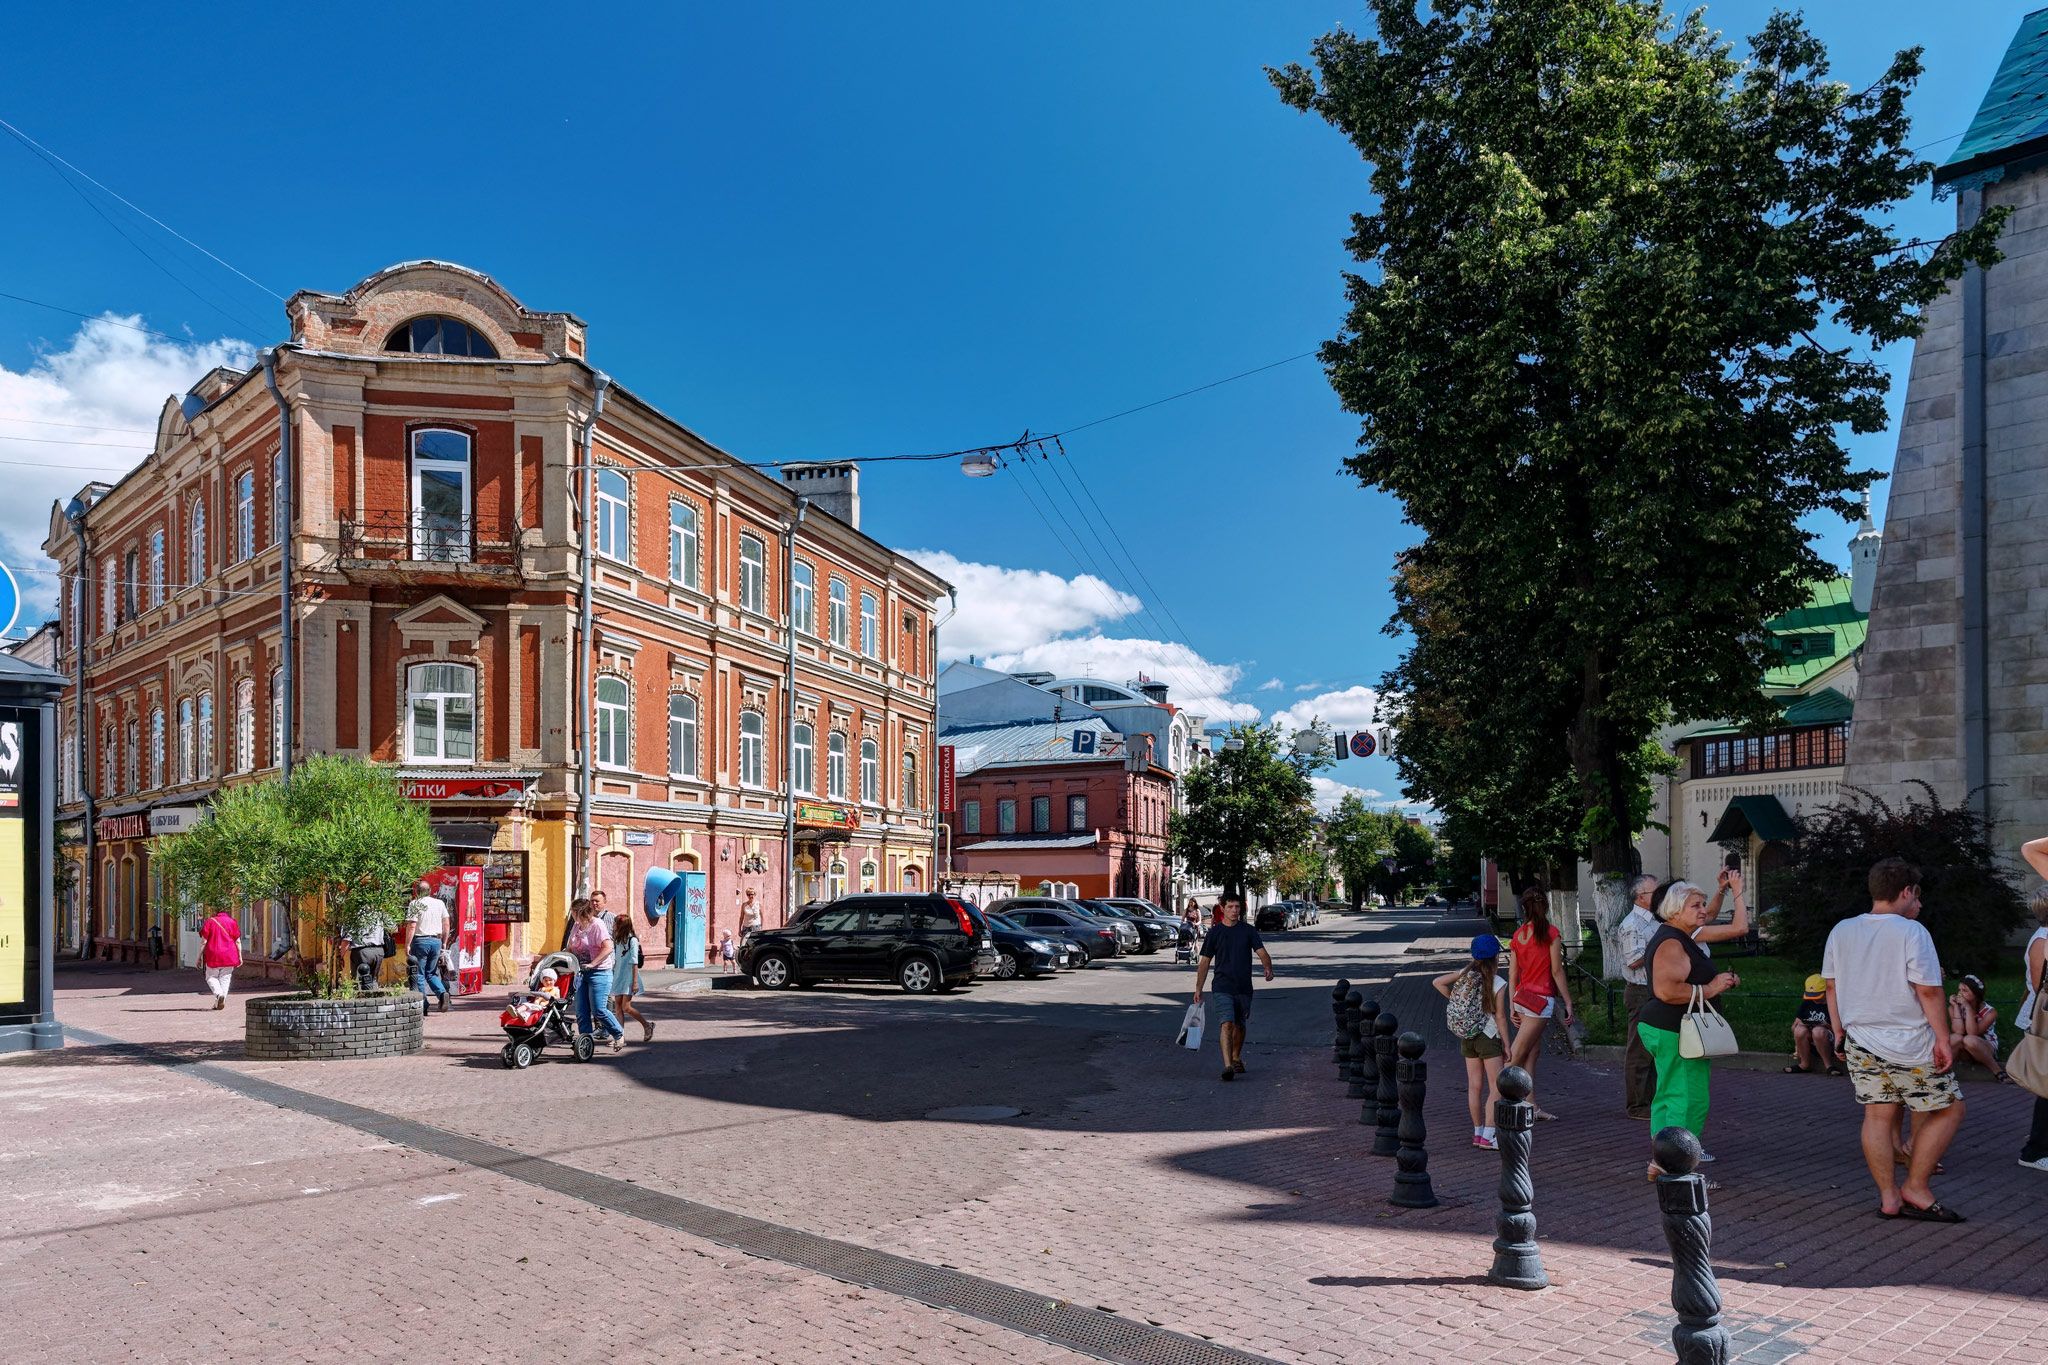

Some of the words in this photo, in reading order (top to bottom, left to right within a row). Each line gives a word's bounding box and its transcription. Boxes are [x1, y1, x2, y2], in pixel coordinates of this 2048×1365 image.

[1078, 732, 1092, 752] P
[100, 814, 144, 841] ТЕРВОЛИНА
[155, 814, 181, 827] ОБУВИ
